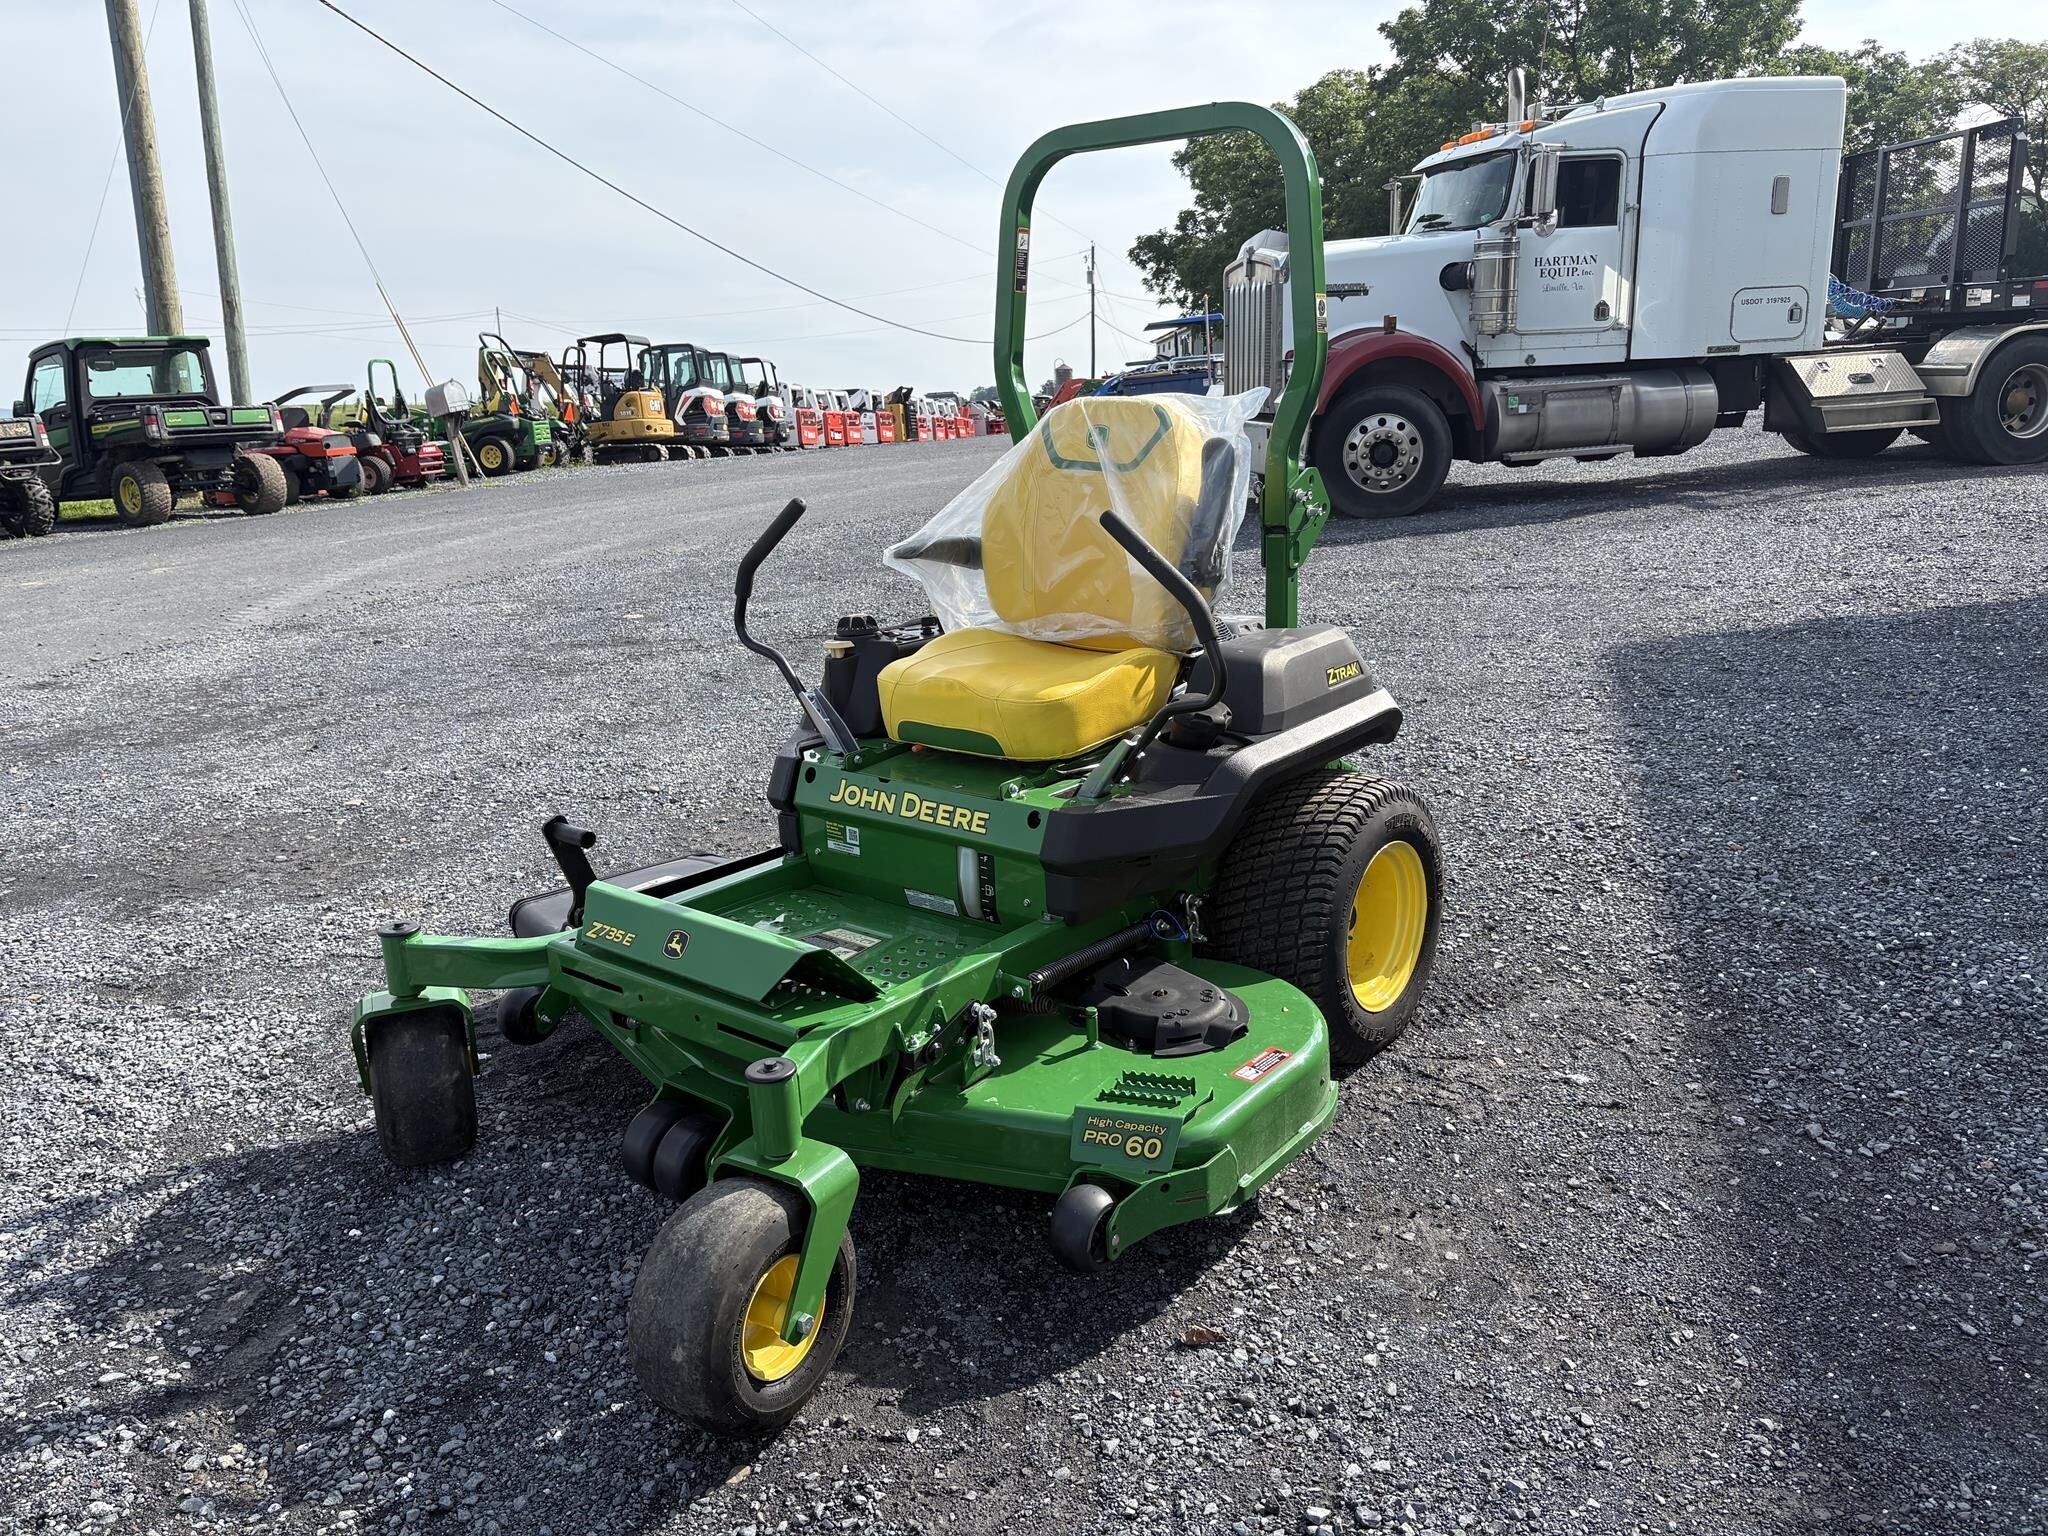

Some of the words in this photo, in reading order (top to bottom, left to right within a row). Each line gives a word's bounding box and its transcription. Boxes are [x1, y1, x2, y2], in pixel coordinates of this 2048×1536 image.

[1534, 254, 1598, 267] HARTMAN
[1540, 267, 1580, 279] EQUIP.
[1326, 662, 1359, 685] ZTRAK
[829, 779, 897, 815] JOHN
[899, 791, 990, 834] DEERE
[1087, 1116, 1113, 1128] High
[1115, 1119, 1168, 1135] Capacity
[1083, 1130, 1123, 1147] PRO
[1124, 1135, 1163, 1160] 60
